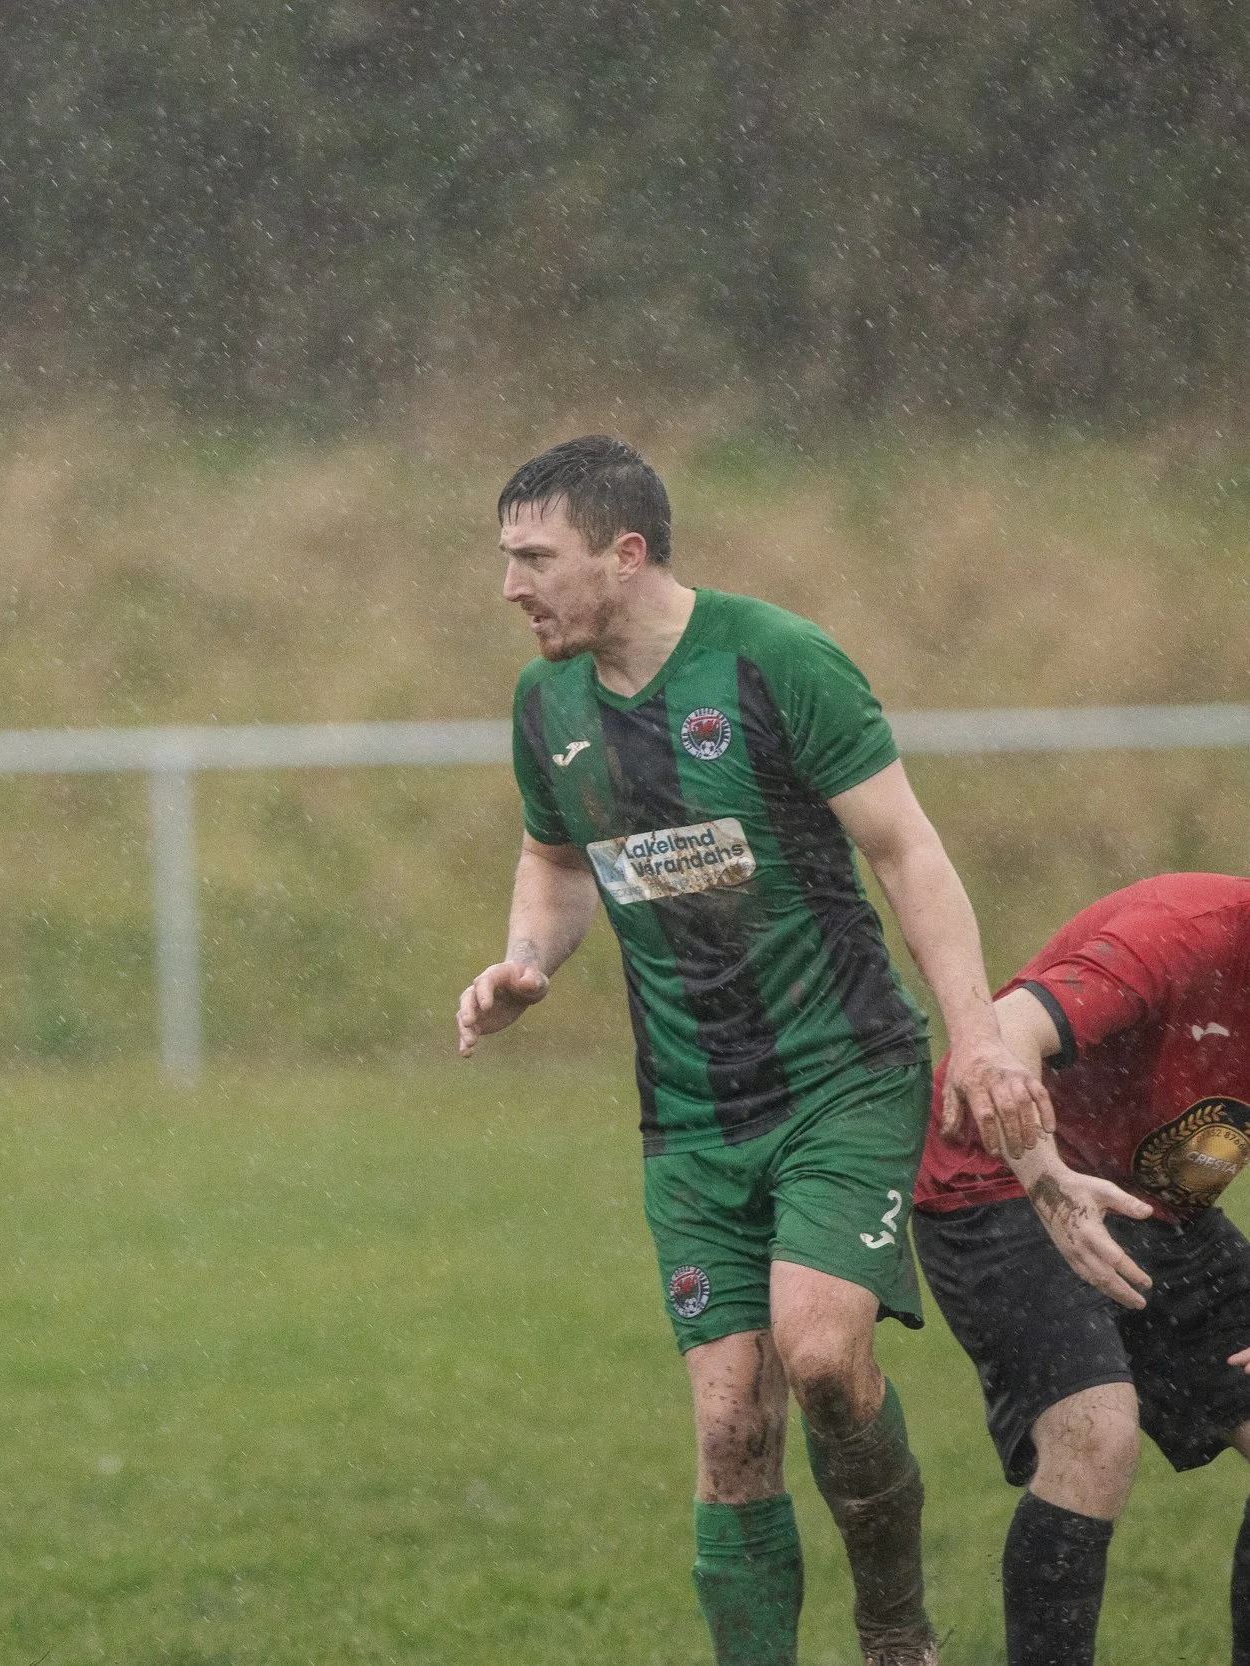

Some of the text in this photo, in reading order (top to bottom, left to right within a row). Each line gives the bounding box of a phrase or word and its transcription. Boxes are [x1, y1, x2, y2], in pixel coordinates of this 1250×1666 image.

[624, 829, 716, 860] Lakeland
[630, 843, 744, 878] Verandahs
[1187, 1150, 1237, 1175] CRESTA
